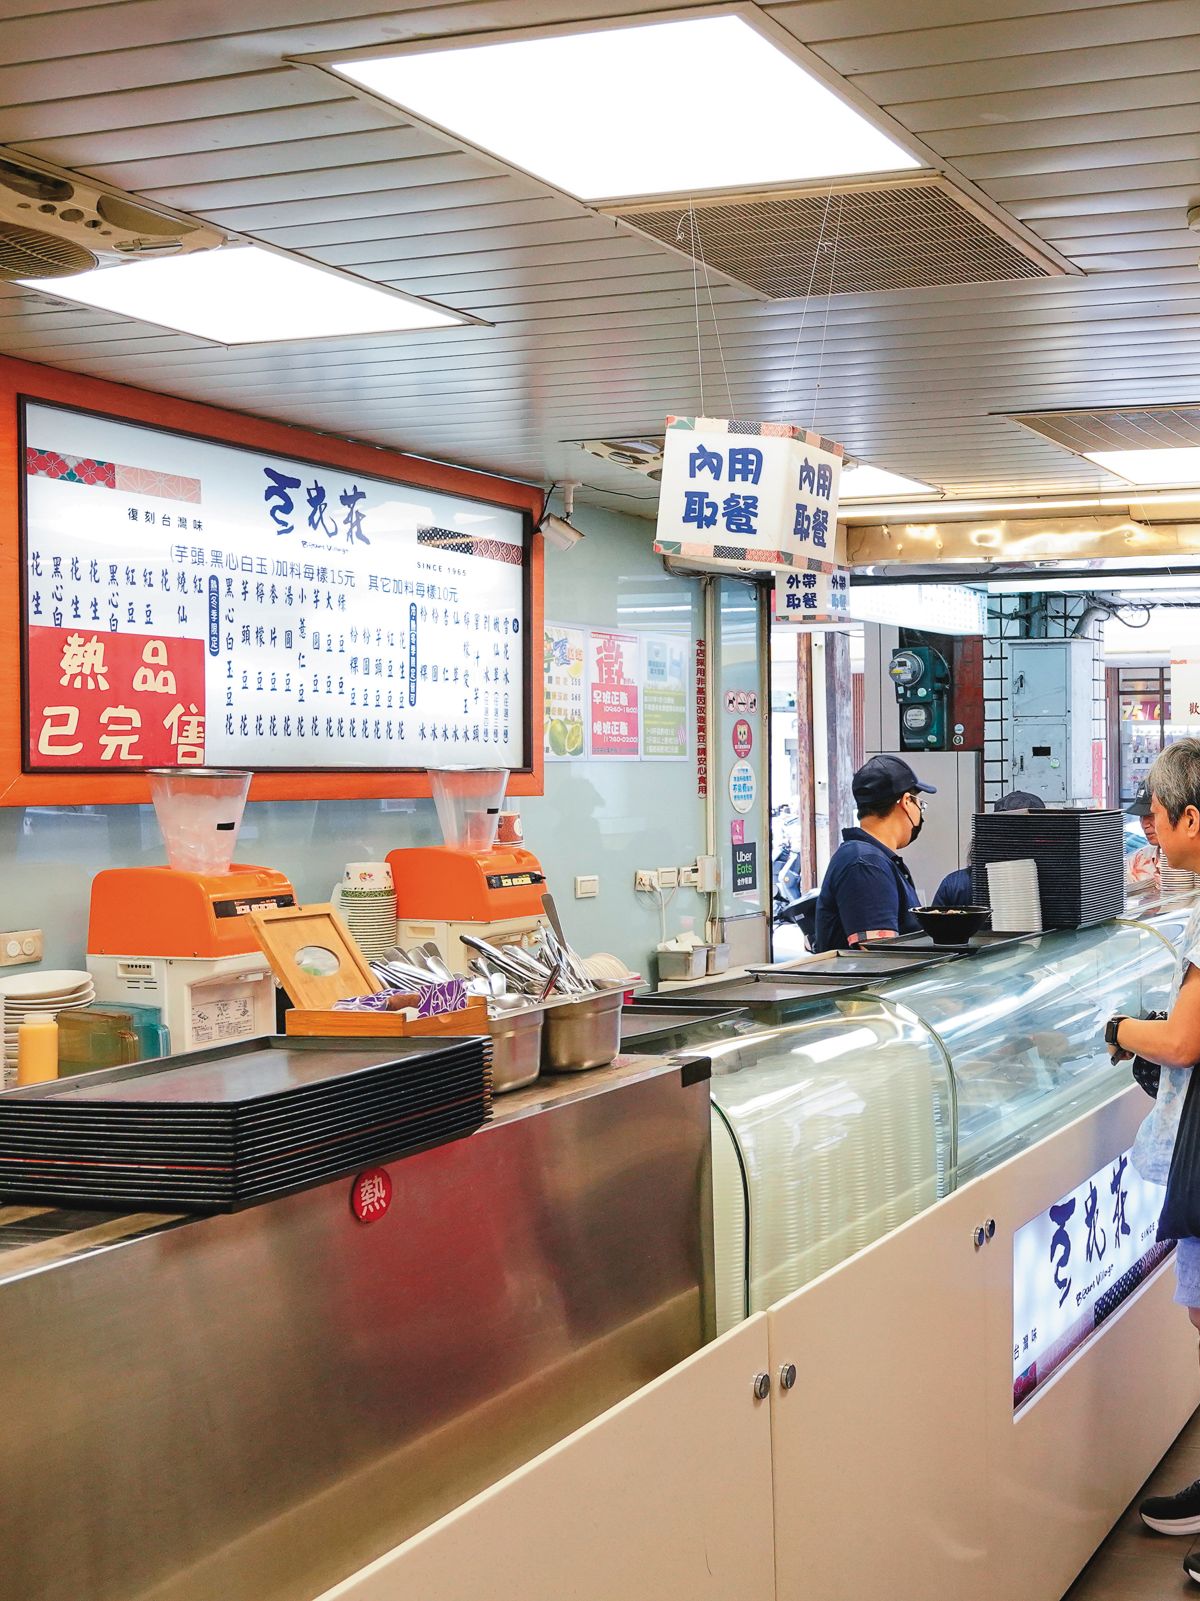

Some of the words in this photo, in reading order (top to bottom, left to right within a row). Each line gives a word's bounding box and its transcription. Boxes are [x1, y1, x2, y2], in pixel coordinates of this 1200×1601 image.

[689, 444, 763, 485] 內用
[799, 457, 833, 500] 內用
[128, 507, 203, 531] 復刻台灣味
[682, 491, 759, 535] 取餐
[793, 503, 829, 548] 取餐
[416, 561, 443, 573] SINCE
[786, 573, 817, 590] 外帶
[785, 592, 818, 610] 取餐
[59, 632, 177, 695] 熱品
[38, 703, 205, 765] 已完售
[736, 851, 752, 863] Uber
[736, 863, 752, 874] Eats
[360, 1175, 386, 1216] 熱
